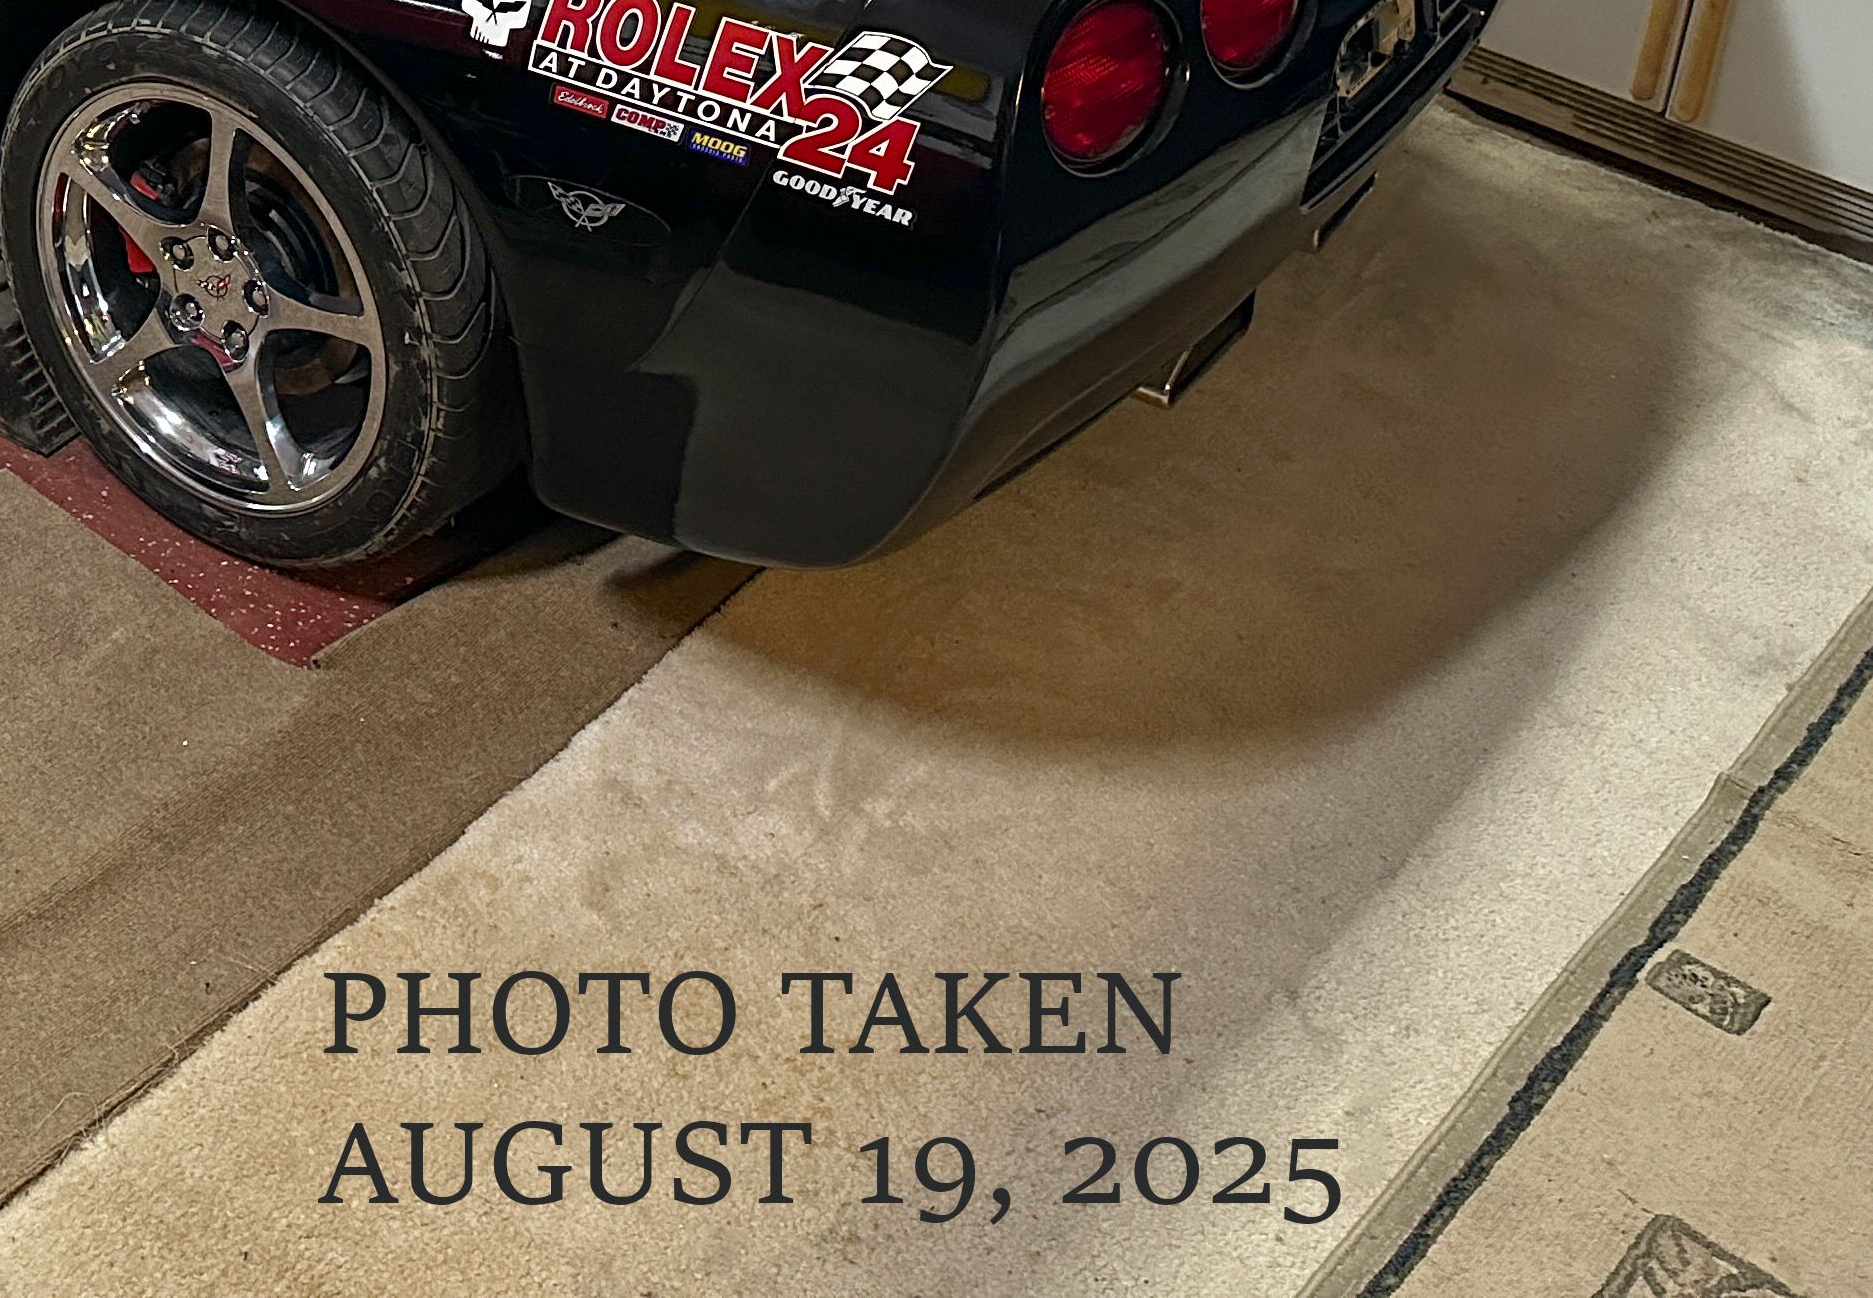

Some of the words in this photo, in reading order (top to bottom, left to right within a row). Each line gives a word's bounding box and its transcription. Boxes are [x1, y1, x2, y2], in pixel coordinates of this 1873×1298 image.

[539, 53, 586, 80] AT
[595, 67, 779, 144] DAYTONA
[615, 108, 667, 132] COMP
[691, 132, 748, 159] MOOG
[779, 92, 922, 195] 24
